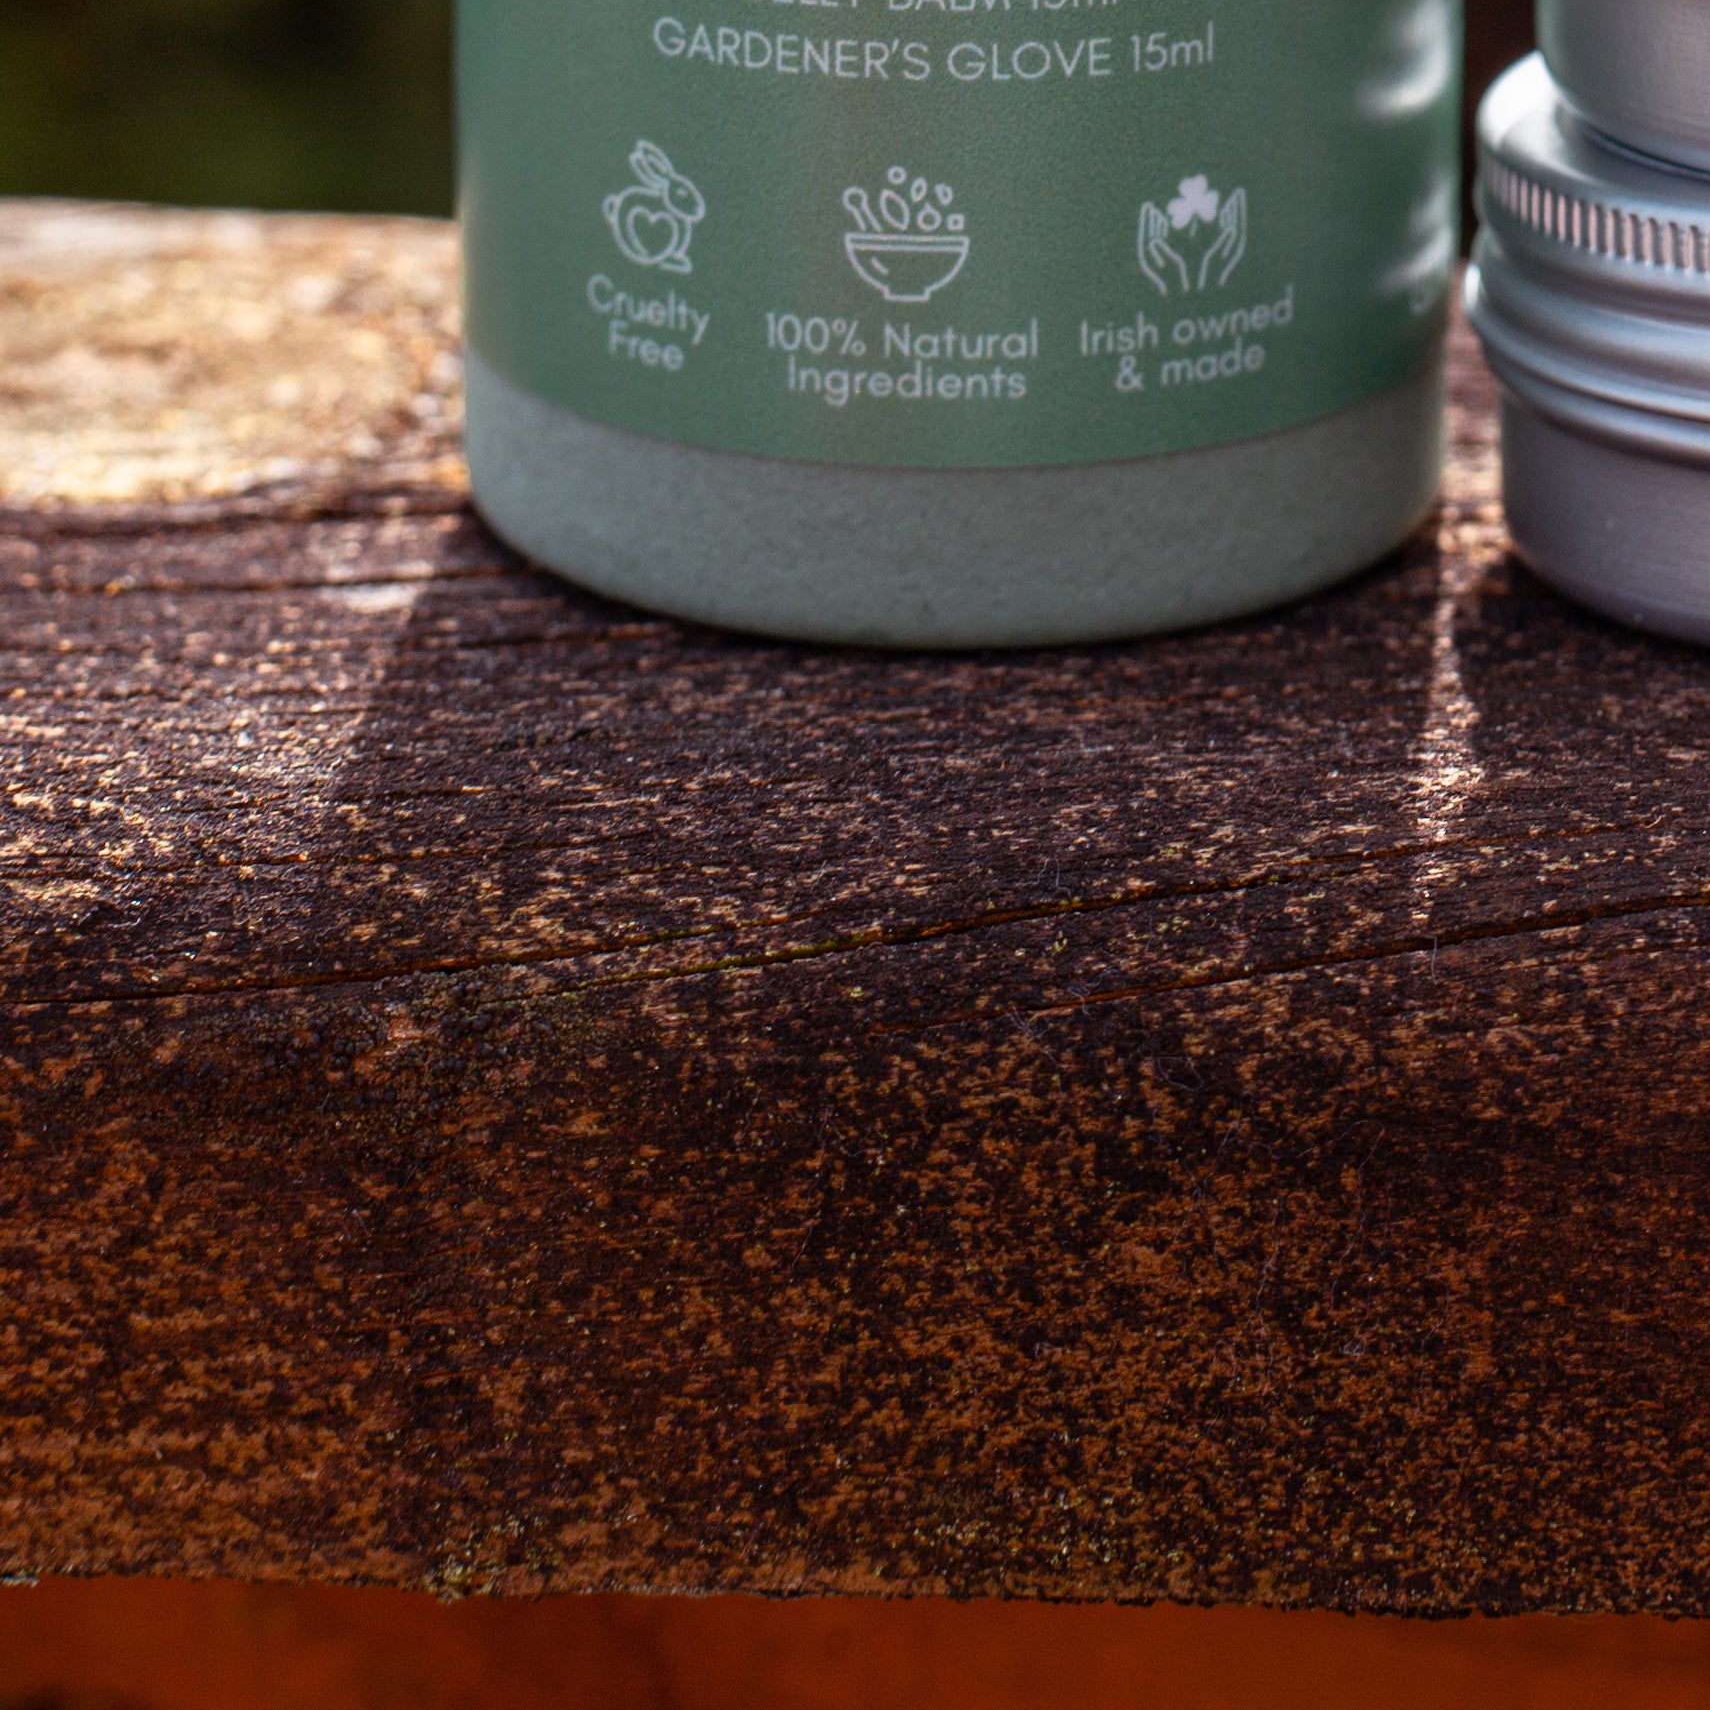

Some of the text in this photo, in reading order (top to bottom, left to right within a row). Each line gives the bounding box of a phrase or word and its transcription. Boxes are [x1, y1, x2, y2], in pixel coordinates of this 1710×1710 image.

[653, 17, 1214, 82] GARDENER'S GLOVE 15ml
[587, 274, 711, 345] Cruelty
[1080, 286, 1294, 357] Irish owned
[609, 319, 685, 371] Free
[765, 313, 1038, 360] 100% Natural
[788, 354, 1027, 405] Ingredients
[1116, 340, 1265, 391] & made
